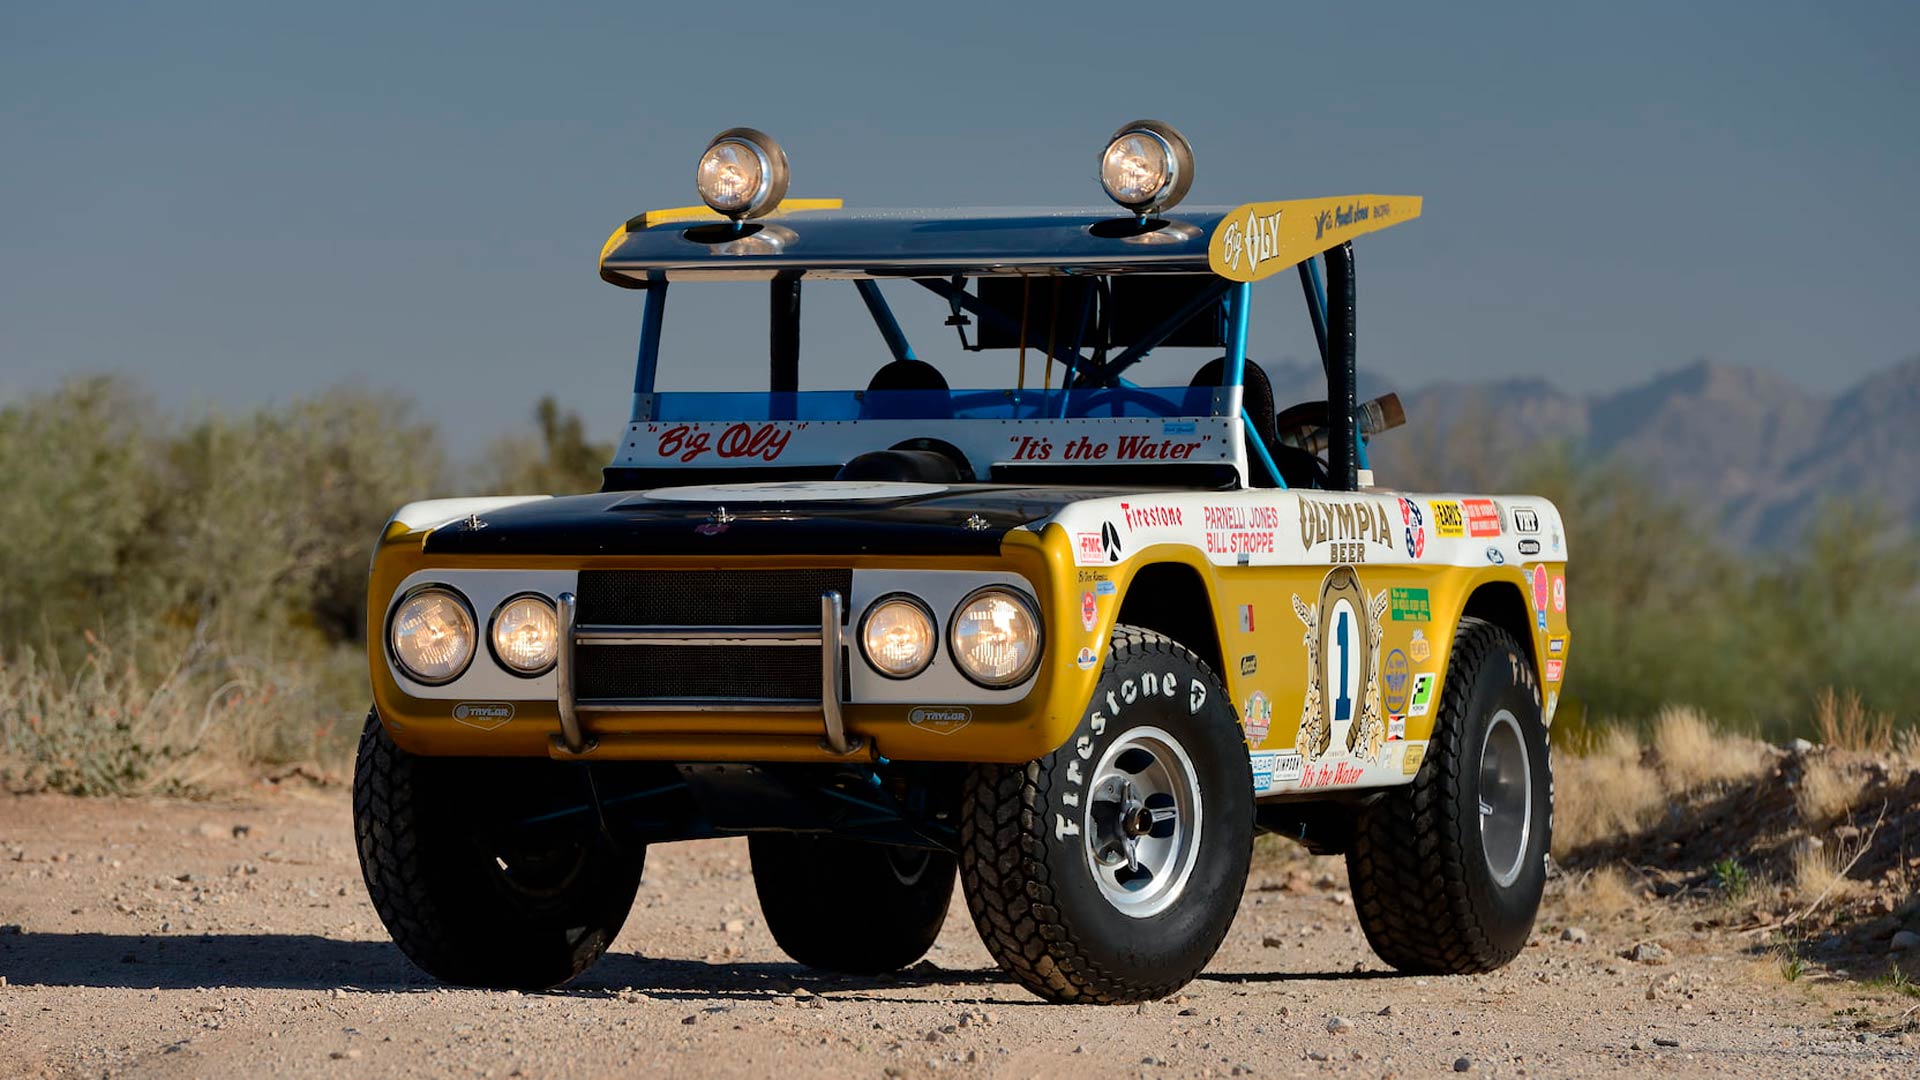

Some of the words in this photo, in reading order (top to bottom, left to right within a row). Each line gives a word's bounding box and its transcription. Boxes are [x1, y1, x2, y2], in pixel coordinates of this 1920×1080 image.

[1223, 219, 1243, 272] Big
[1244, 207, 1283, 276] OLY
[1063, 436, 1109, 460] the
[1120, 502, 1183, 533] Firestone
[1203, 506, 1246, 529] PARNELLI
[1249, 506, 1279, 529] JONES
[1297, 493, 1393, 552] OLYMPIA
[1437, 503, 1463, 526] EARL'S
[1206, 532, 1228, 553] BILL
[1230, 532, 1275, 553] STROPPE
[1330, 543, 1365, 563] BEER
[1334, 611, 1352, 721] 1
[470, 708, 509, 717] TAYLOR
[925, 712, 965, 721] TAYLOR
[1055, 671, 1178, 842] Firestone
[1275, 756, 1300, 772] SIMPSON
[1299, 764, 1315, 788] It's
[1316, 763, 1334, 787] the
[1334, 761, 1364, 785] Water
